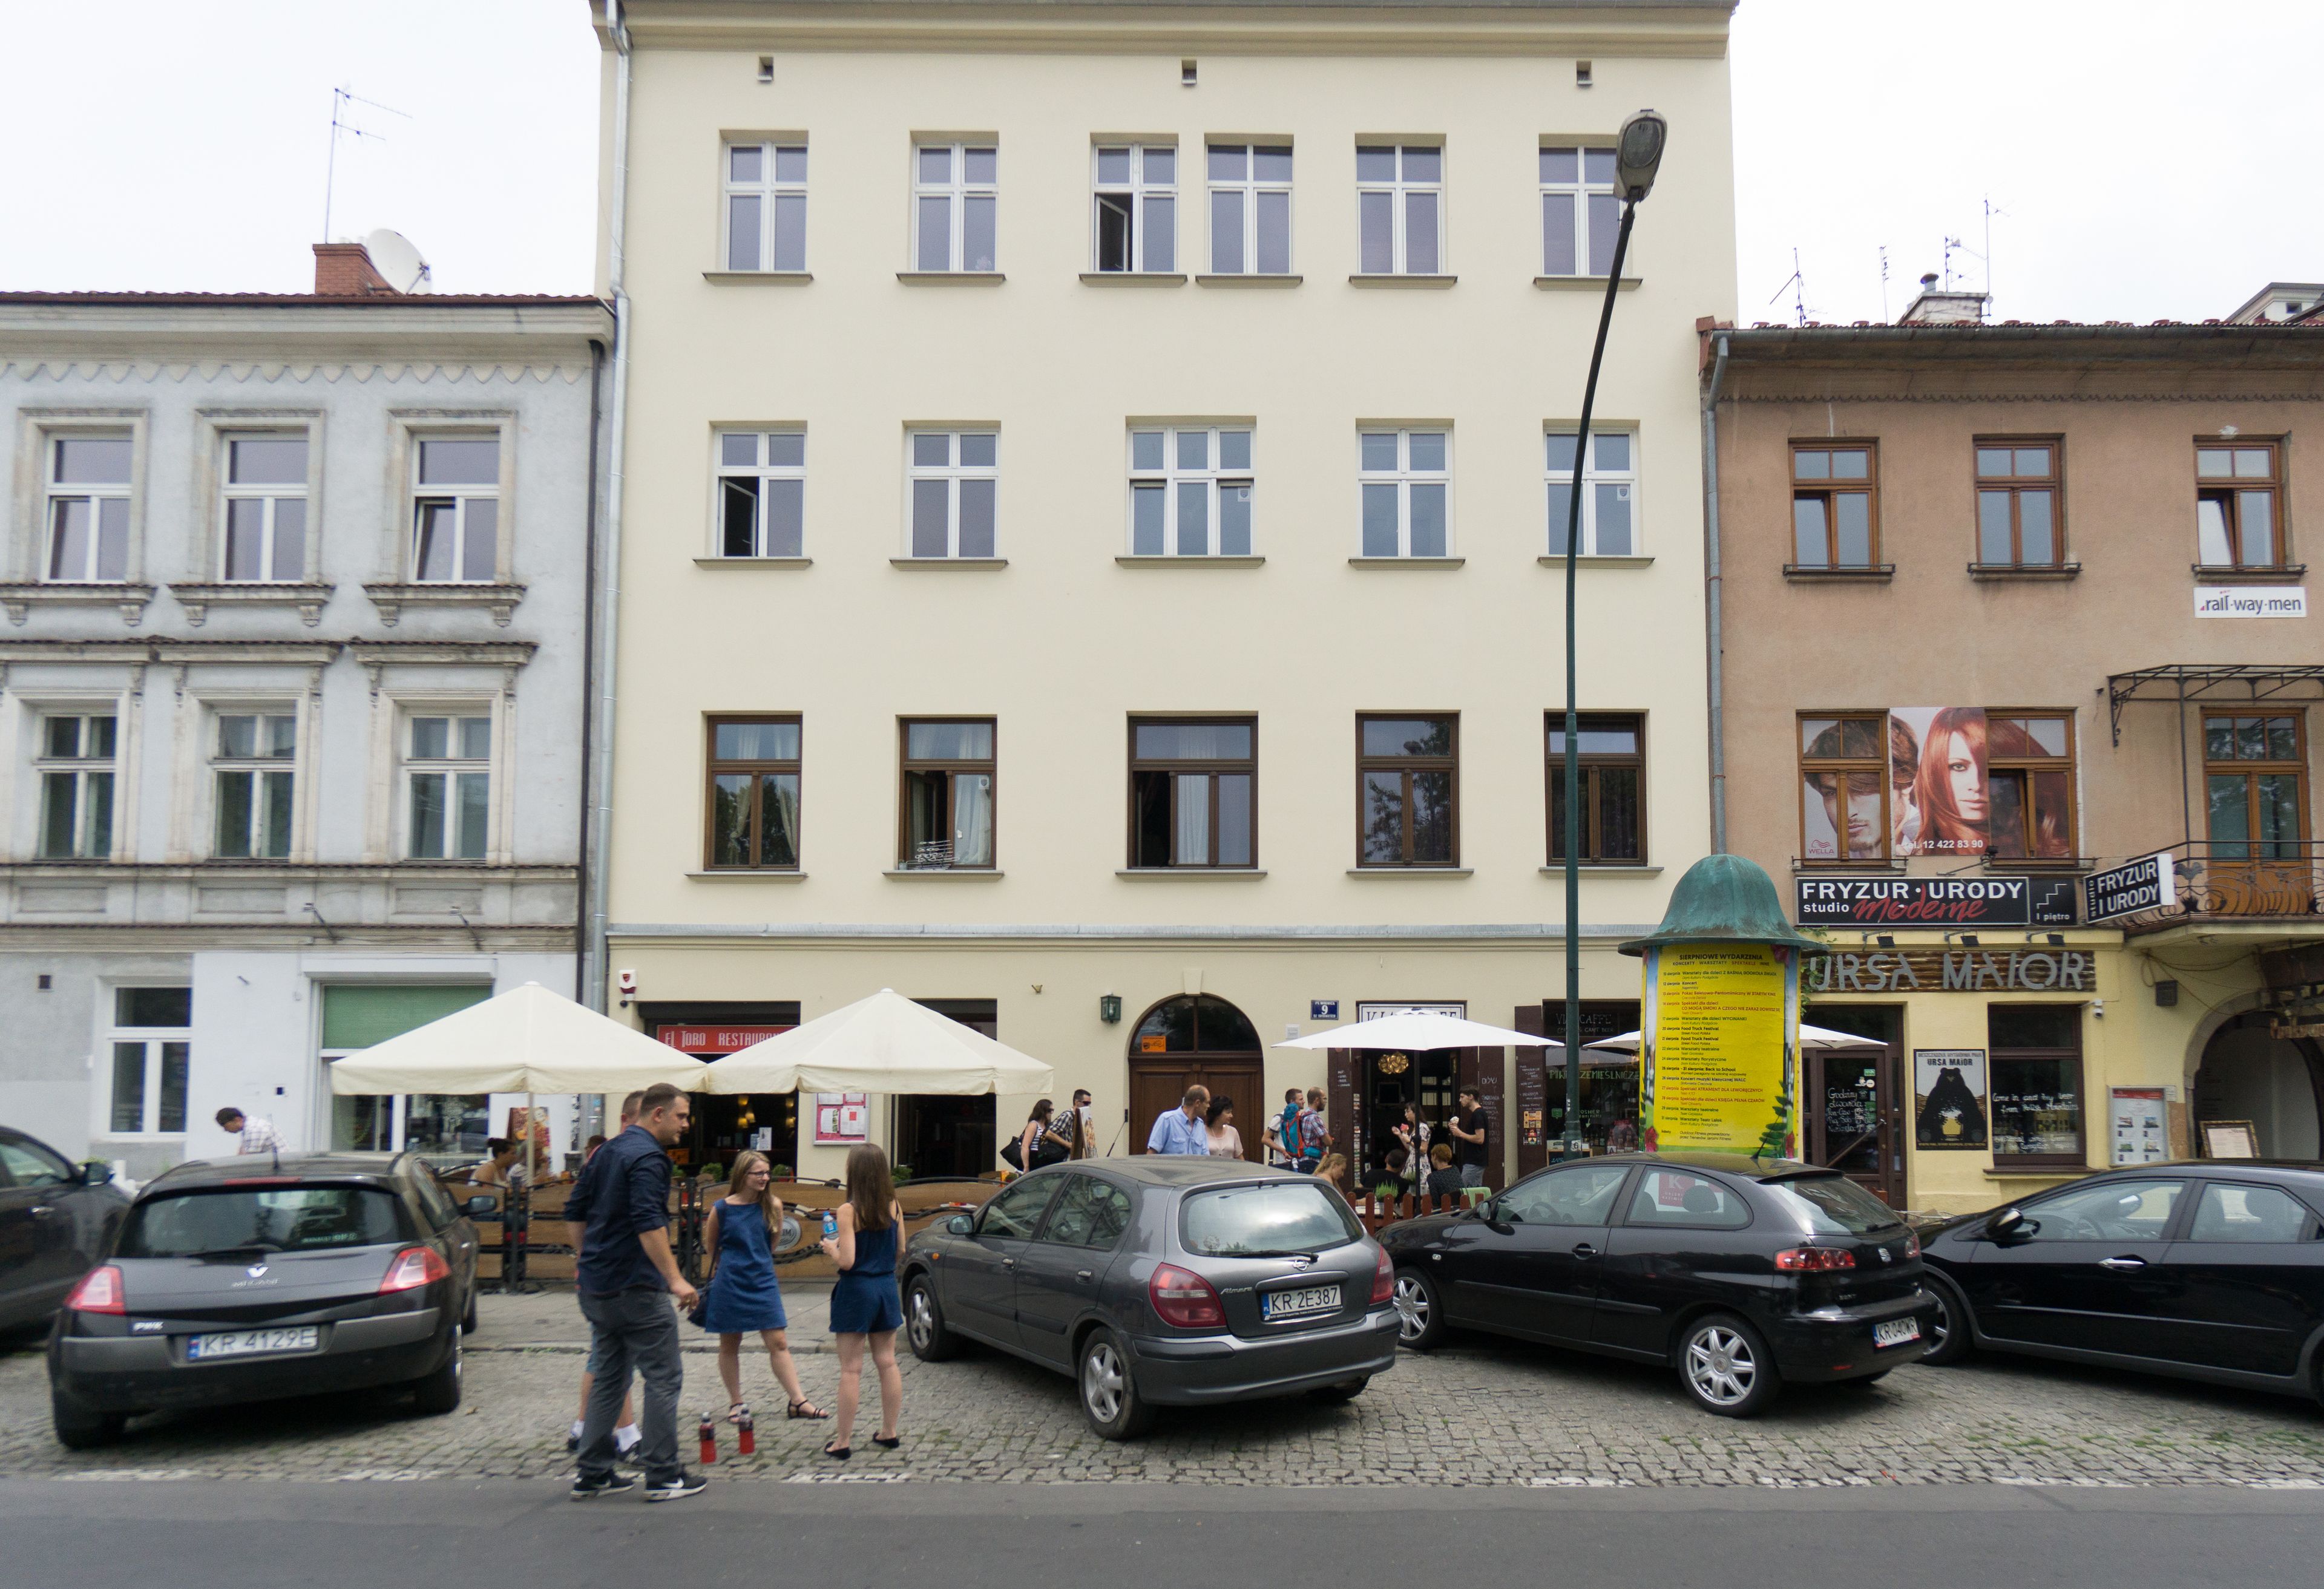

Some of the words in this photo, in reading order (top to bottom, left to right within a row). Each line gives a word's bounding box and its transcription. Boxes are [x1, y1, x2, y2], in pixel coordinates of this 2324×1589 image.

[1923, 840, 1934, 848] 12
[1937, 840, 1955, 848] 422
[2097, 862, 2157, 894] FRYZUR
[1802, 882, 1909, 899] FRYZUR
[1929, 882, 2023, 899] URODY
[2088, 880, 2097, 917] studio
[2098, 899, 2104, 915] I
[2107, 883, 2159, 912] URODY
[1804, 901, 1850, 913] studio
[1853, 883, 1988, 922] Moderne
[2043, 912, 2070, 922] piętro
[1808, 952, 1919, 991] URSA
[1943, 952, 2084, 990] MAIOR
[1321, 1004, 1328, 1015] 9
[666, 1030, 676, 1047] EL
[681, 1030, 706, 1047] TORO
[1579, 1069, 1640, 1080] ZEMIEŚLNICZE
[1220, 1286, 1253, 1295] Almera
[1272, 1293, 1293, 1312] KR
[1298, 1287, 1338, 1308] 2E387
[203, 1334, 237, 1354] KR
[245, 1328, 317, 1349] 4129E
[1877, 1323, 1892, 1342] KR
